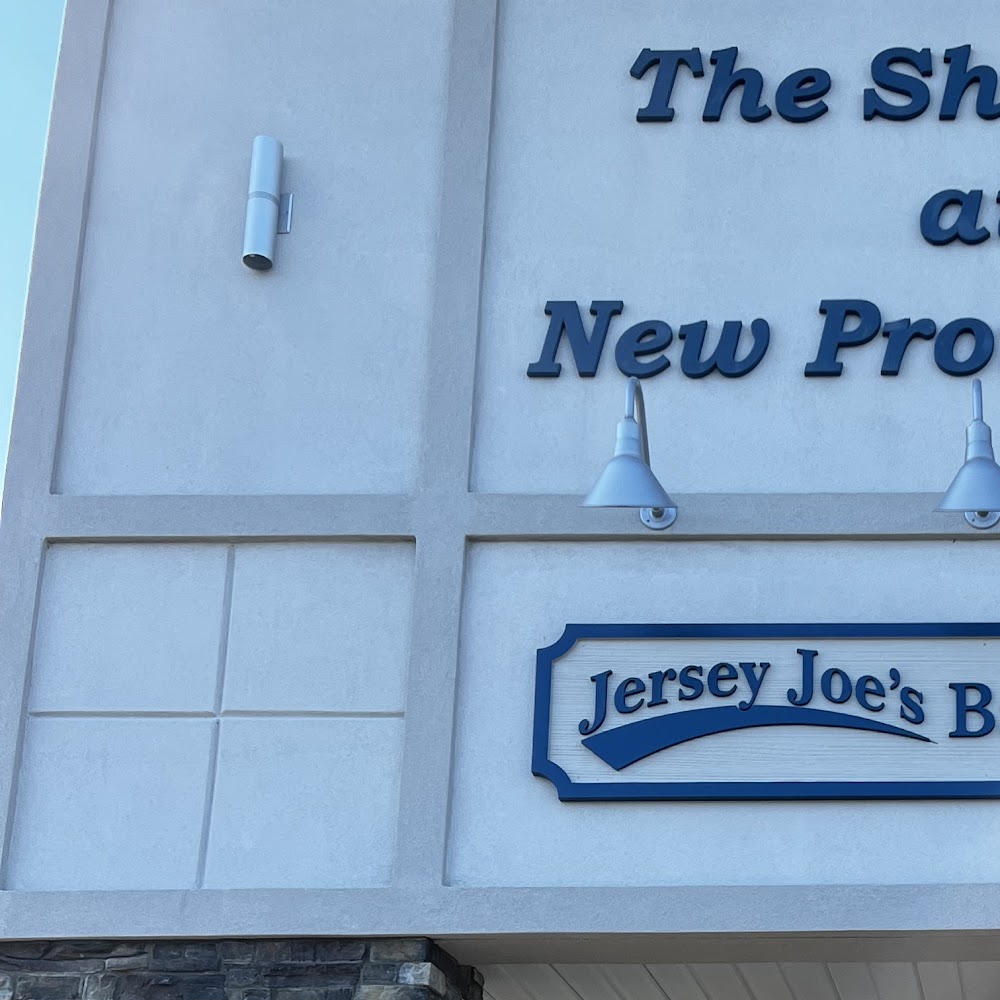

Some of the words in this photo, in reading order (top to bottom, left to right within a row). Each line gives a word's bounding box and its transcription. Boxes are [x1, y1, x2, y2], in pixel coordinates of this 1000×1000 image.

[630, 46, 832, 125] The
[527, 300, 770, 380] New
[578, 661, 770, 736] Jersey
[786, 649, 926, 725] Joe's
